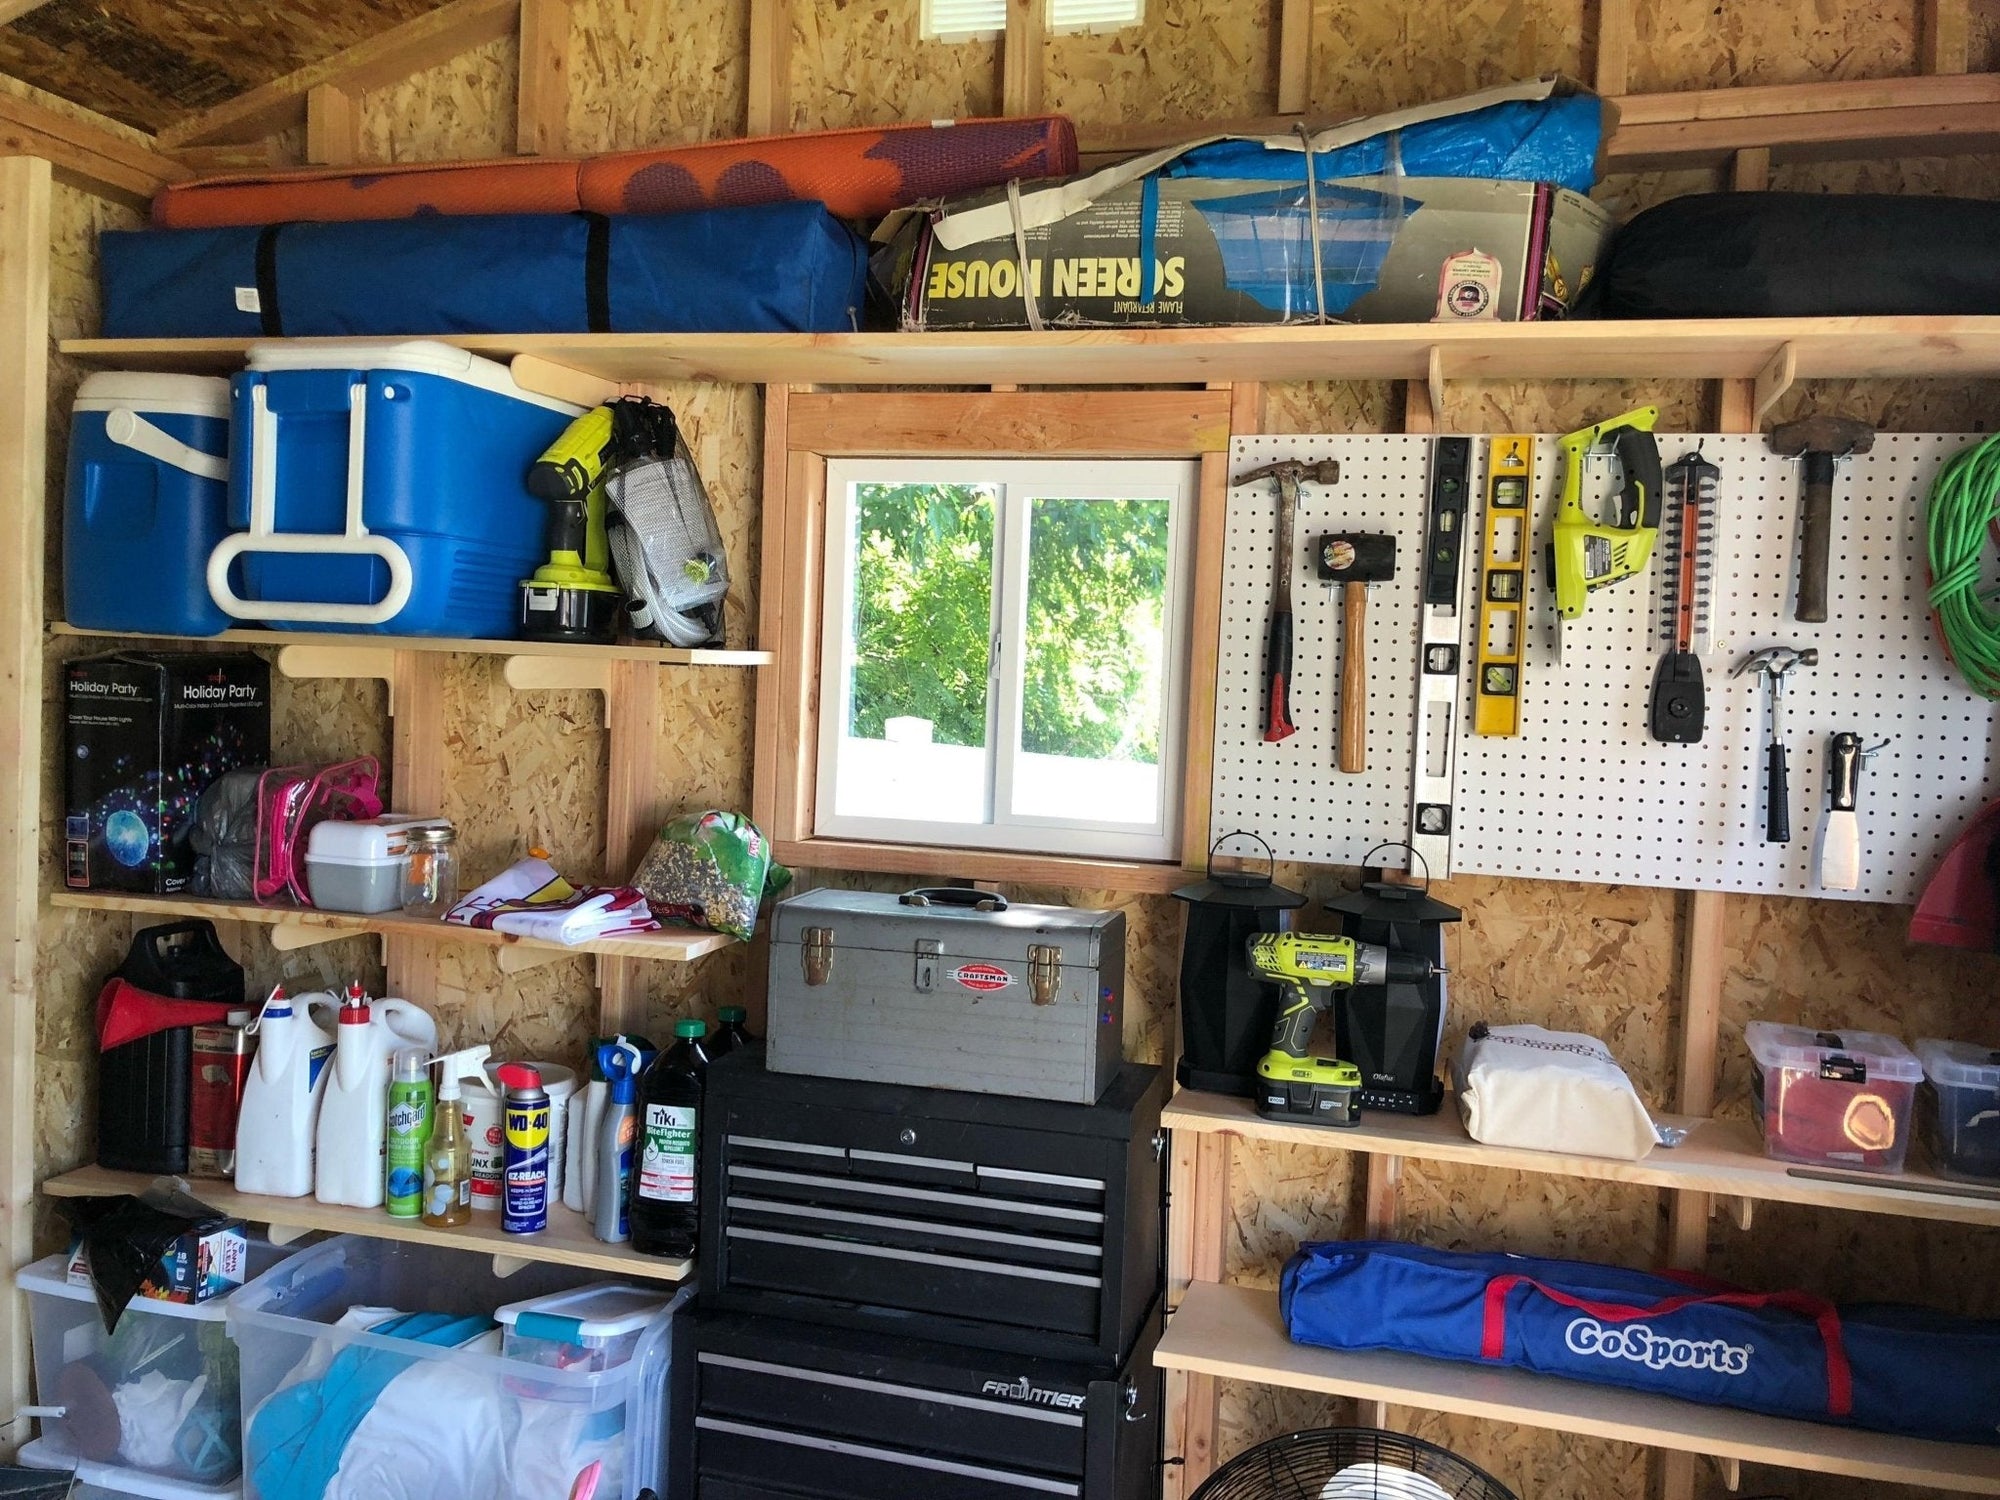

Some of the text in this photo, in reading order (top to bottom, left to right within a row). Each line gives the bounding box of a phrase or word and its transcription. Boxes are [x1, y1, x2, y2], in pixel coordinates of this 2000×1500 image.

[928, 256, 1184, 298] SCREEN HOUSE
[1158, 301, 1183, 314] FLAME
[70, 681, 137, 696] Holiday Party
[183, 684, 256, 700] Holiday Party
[165, 878, 185, 886] Cover
[957, 972, 1008, 982] CRAFTSMAN
[508, 1112, 547, 1131] WD-40
[508, 1170, 546, 1181] EZ-REACH
[1565, 1317, 1749, 1375] GoSports
